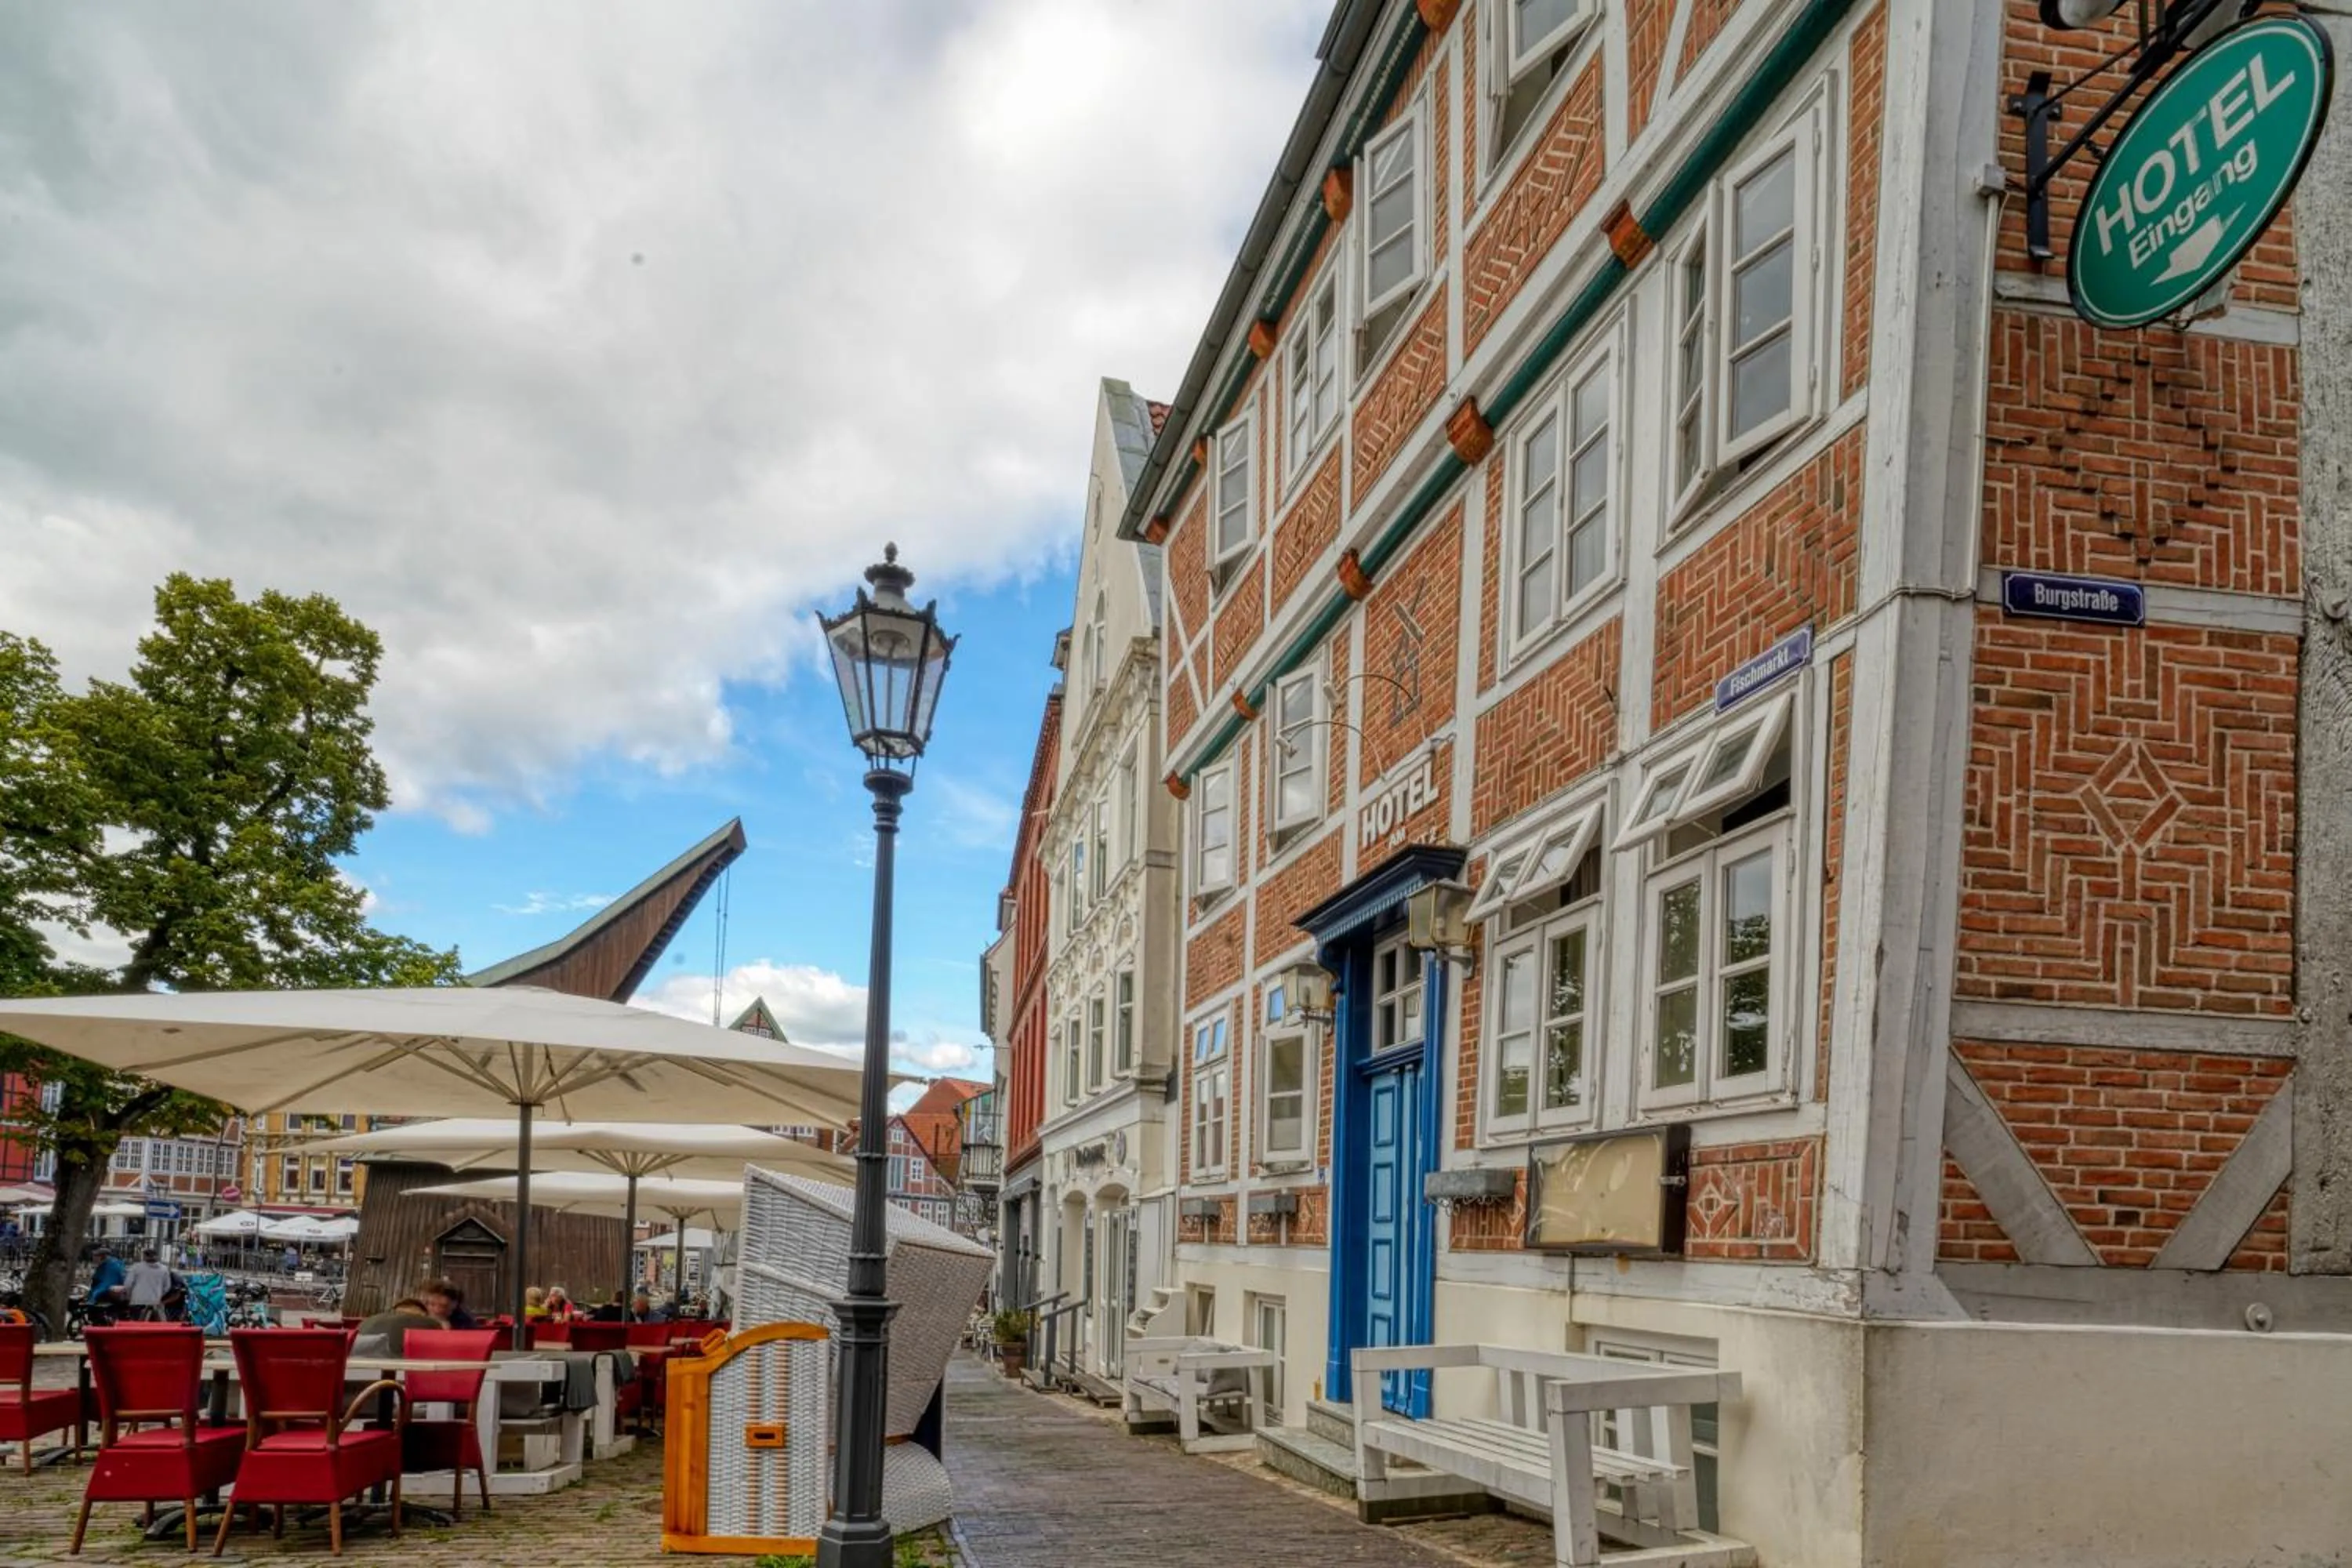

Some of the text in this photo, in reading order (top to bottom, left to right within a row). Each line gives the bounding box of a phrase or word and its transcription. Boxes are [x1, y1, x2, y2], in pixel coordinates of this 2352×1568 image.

[2095, 52, 2296, 257] HOTEL
[2128, 137, 2259, 270] Eingang
[2034, 583, 2119, 612] Burgstraße
[1730, 644, 1789, 697] Fischmarkt
[1362, 760, 1439, 849] HOTEL
